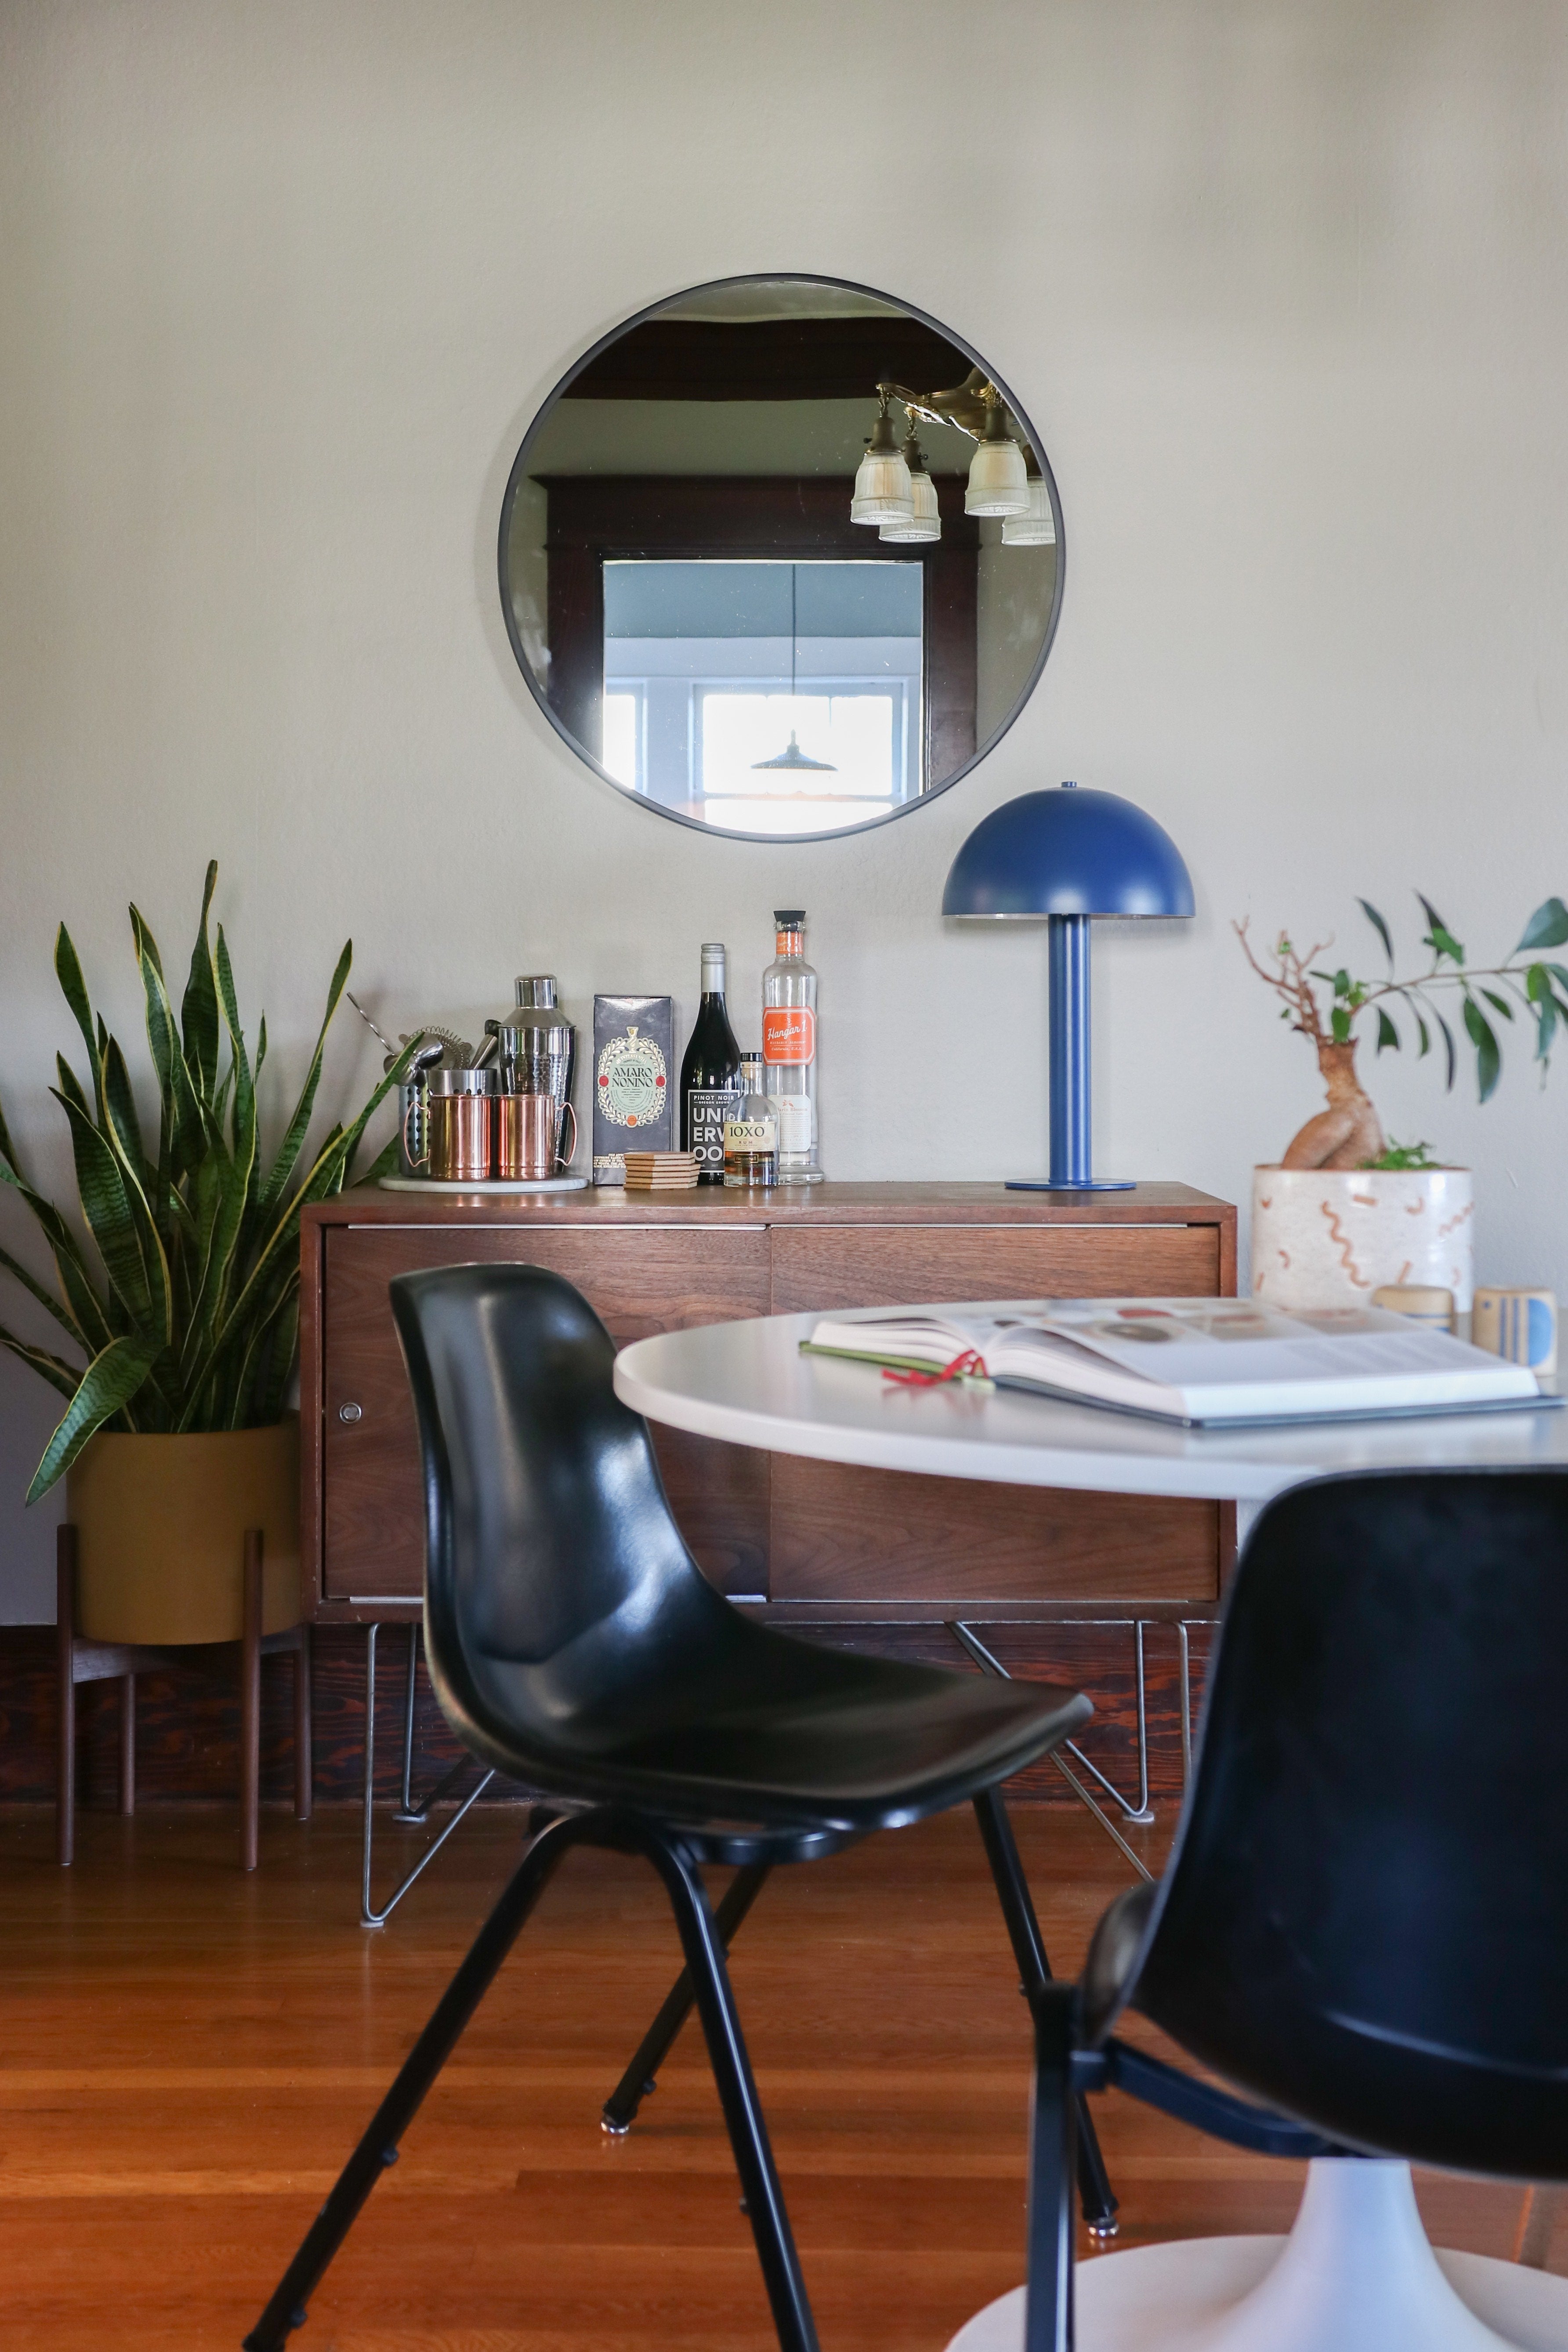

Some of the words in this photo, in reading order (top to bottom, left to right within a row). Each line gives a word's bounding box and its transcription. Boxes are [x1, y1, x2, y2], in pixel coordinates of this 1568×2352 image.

[767, 1026, 801, 1041] Hangar
[801, 1020, 806, 1032] 1
[612, 1067, 652, 1078] AMARO
[612, 1078, 653, 1087] NONINO
